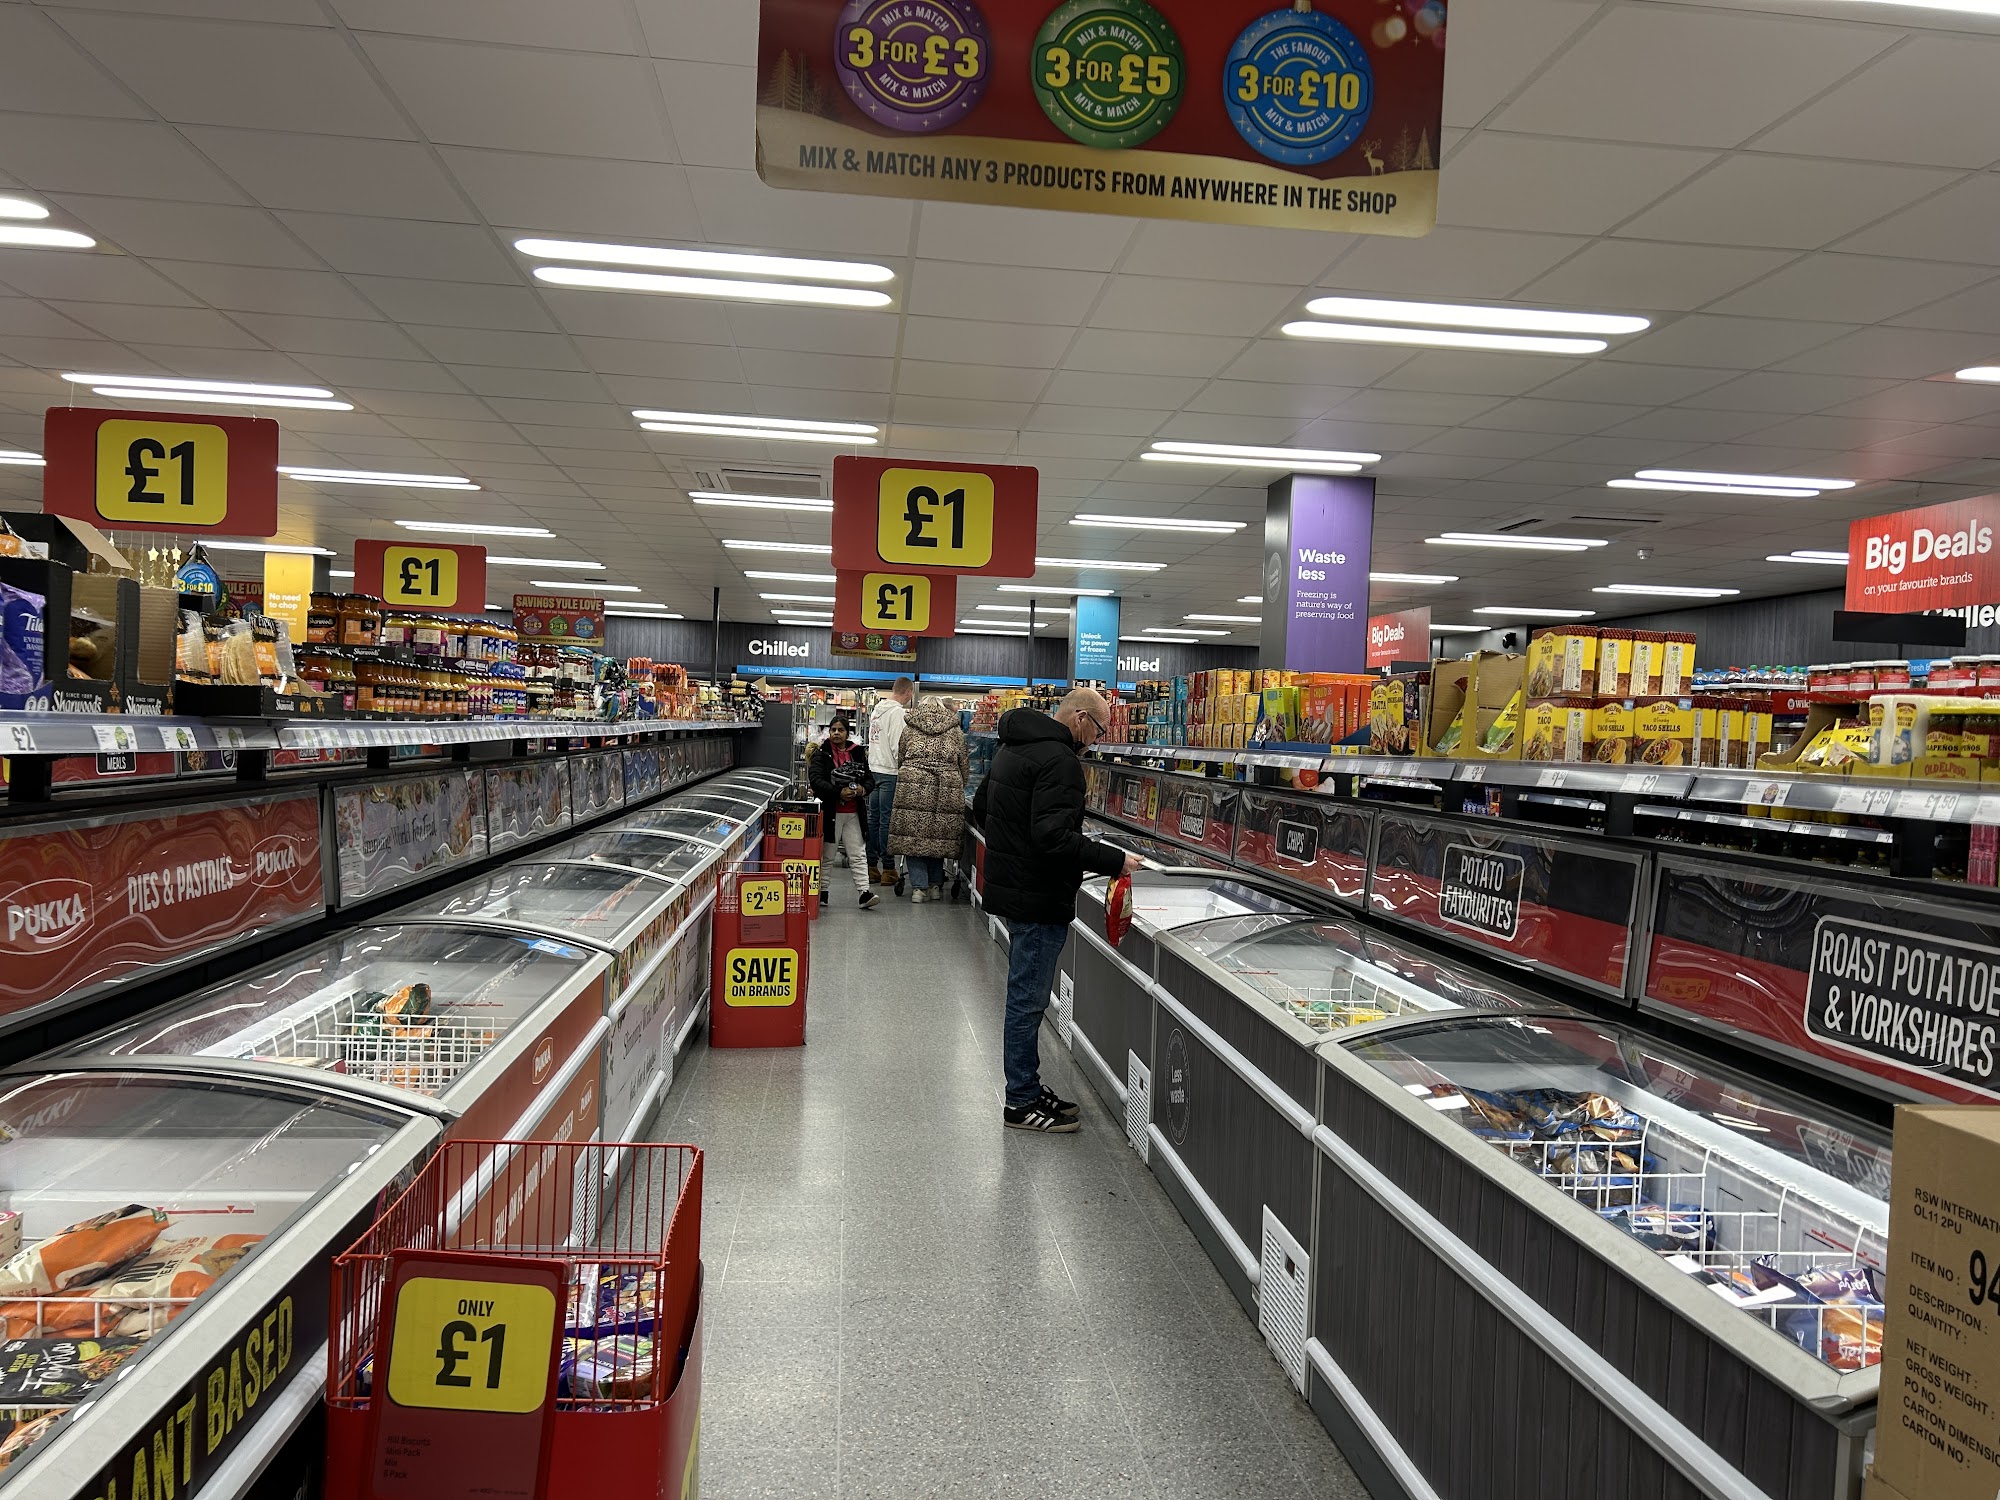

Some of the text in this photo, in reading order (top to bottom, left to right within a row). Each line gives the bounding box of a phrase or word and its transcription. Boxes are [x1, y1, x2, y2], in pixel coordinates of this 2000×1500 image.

[881, 6, 950, 32] MIX & MATCH
[1076, 25, 1144, 52] MIX & MATCH
[848, 27, 980, 80] 3 FOR £3
[1269, 41, 1332, 66] THE FAMOUS
[1045, 47, 1172, 95] 3 FOR £5
[878, 72, 948, 99] MIX & MATCH
[1238, 64, 1360, 111] 3 FOR £10
[1074, 91, 1141, 118] MIX & MATCH
[1264, 107, 1331, 134] MIX & MATCH
[799, 143, 1398, 215] MIX & MATCH ANY 3 PRODUCTS FROM ANYWHERE IN THE SHOP
[125, 437, 195, 506] £1
[903, 485, 965, 549] £1
[1298, 549, 1346, 565] Waste
[1865, 519, 1993, 575] Big Deals
[399, 556, 440, 596] £1
[1298, 566, 1326, 580] less
[1864, 572, 1973, 596] on your favourite brands
[269, 593, 301, 601] No need
[279, 602, 298, 611] chop
[516, 596, 602, 611] SAVINGS YULE LOVE
[877, 583, 914, 621] £1
[1296, 590, 1329, 600] Freezing
[1295, 611, 1355, 620] preserving food
[1080, 632, 1102, 640] Unlock
[1371, 622, 1405, 647] Big Deals
[748, 639, 809, 657] Chilled
[1541, 645, 1552, 654] TACO
[1117, 656, 1160, 672] hilled
[1371, 701, 1386, 709] FAJITA
[1651, 706, 1660, 714] OLD
[1537, 716, 1551, 725] TACO
[11, 726, 36, 750] £2
[106, 756, 127, 771] MEALS
[1924, 761, 1967, 776] OLD EL PASO
[1640, 775, 1657, 792] £2
[1862, 790, 1890, 812] £1.50
[1926, 793, 1957, 818] £1.50
[781, 823, 802, 836] £2.45
[1286, 829, 1305, 854] CHIPS
[257, 846, 296, 878] PUKKA
[1459, 855, 1504, 891] POTATO
[128, 855, 233, 914] PIES & PASTRIES
[747, 891, 780, 910] £2.45
[1444, 884, 1513, 930] FAVOURITES
[7, 893, 86, 942] PUKKA
[732, 957, 792, 983] SAVE
[1819, 929, 2000, 1017] ROAST POTATOE
[732, 985, 791, 997] ON BRANDS
[1824, 985, 1996, 1077] & YORKSHIRES
[534, 1045, 552, 1078] PUKKA
[1171, 1064, 1183, 1083] Less
[1170, 1086, 1185, 1104] waste
[1914, 1187, 1939, 1207] RSW
[1913, 1203, 1962, 1234] OL11 2PU
[1911, 1251, 1954, 1282] ITEM NO
[457, 1299, 495, 1318] ONLY
[1909, 1284, 1981, 1331] DESCRIPTION
[1908, 1303, 1961, 1341] QUANTITY
[435, 1320, 507, 1390] £1
[1906, 1338, 1927, 1358] NET
[1929, 1350, 1972, 1384] WEIGHT
[207, 1295, 293, 1456] BASED
[1905, 1357, 1988, 1415] GROSS WEIGHT
[1904, 1376, 1936, 1405] PO NO
[1903, 1395, 1946, 1432] CARTON
[1902, 1414, 1964, 1464] CARTON NO
